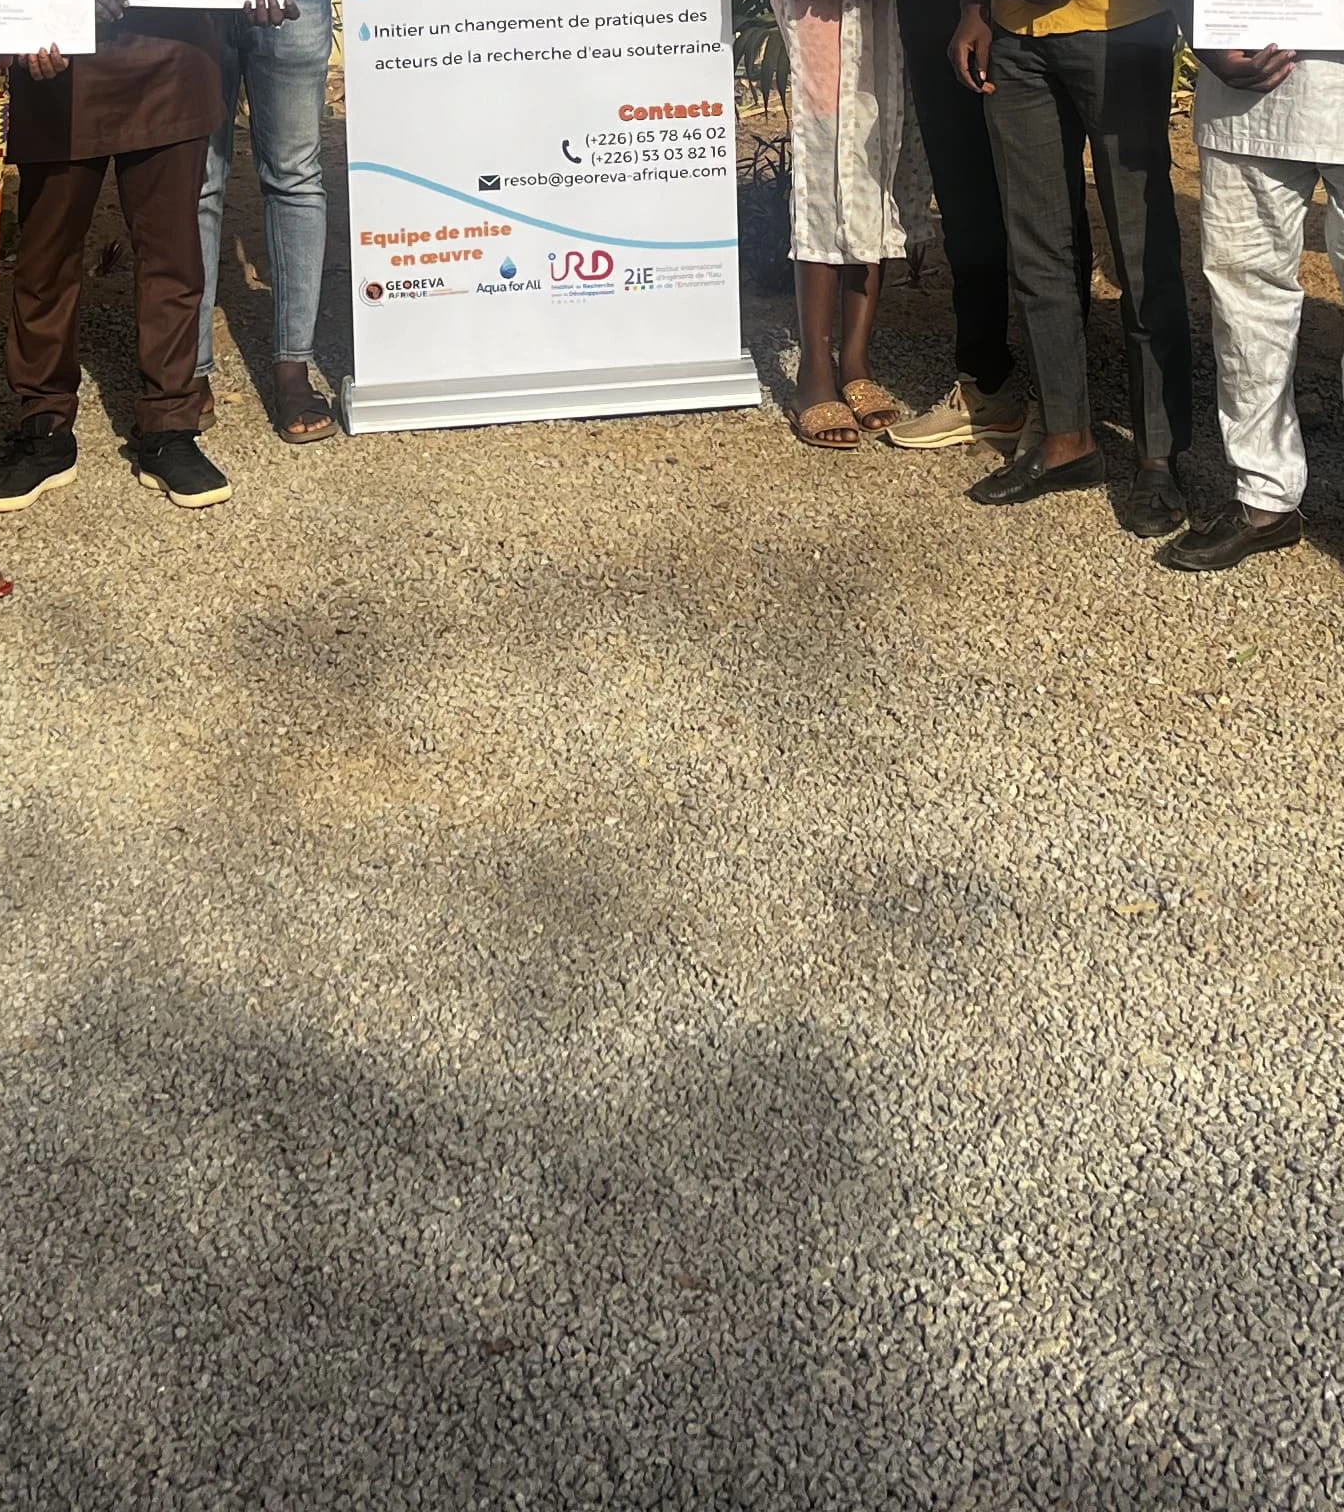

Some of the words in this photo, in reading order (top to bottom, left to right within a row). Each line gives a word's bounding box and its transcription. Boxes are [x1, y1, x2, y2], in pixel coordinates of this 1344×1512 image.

[374, 24, 424, 38] Initier
[429, 23, 450, 35] un
[455, 15, 564, 33] changement
[568, 14, 590, 29] de
[595, 11, 674, 30] pratiques
[678, 9, 708, 23] des
[375, 56, 438, 70] acteurs
[442, 52, 463, 66] de
[468, 49, 482, 64] la
[487, 46, 572, 63] recherche
[576, 45, 622, 60] d'eau
[626, 39, 725, 57] souterraine.
[618, 100, 724, 122] Contacts
[585, 131, 633, 149] (+226)
[636, 130, 655, 143] 65
[659, 129, 678, 142] 78
[682, 128, 702, 141] 46
[705, 127, 726, 139] 02
[591, 150, 639, 167] (+226)
[642, 149, 660, 162] 53
[664, 148, 684, 160] 03
[687, 147, 707, 159] 82
[710, 145, 727, 158] 16
[504, 165, 727, 188] resob@georeva-afrique.com
[360, 228, 432, 248] Equipe
[435, 225, 460, 241] de
[463, 221, 512, 238] mise
[390, 253, 416, 267] en
[419, 248, 484, 265] œuvre
[385, 277, 445, 291] GEOREVA
[475, 281, 507, 295] Aqua
[509, 280, 525, 292] for
[526, 279, 542, 290] All
[624, 267, 654, 286] 2iE
[388, 290, 428, 299] AFRIQUE
